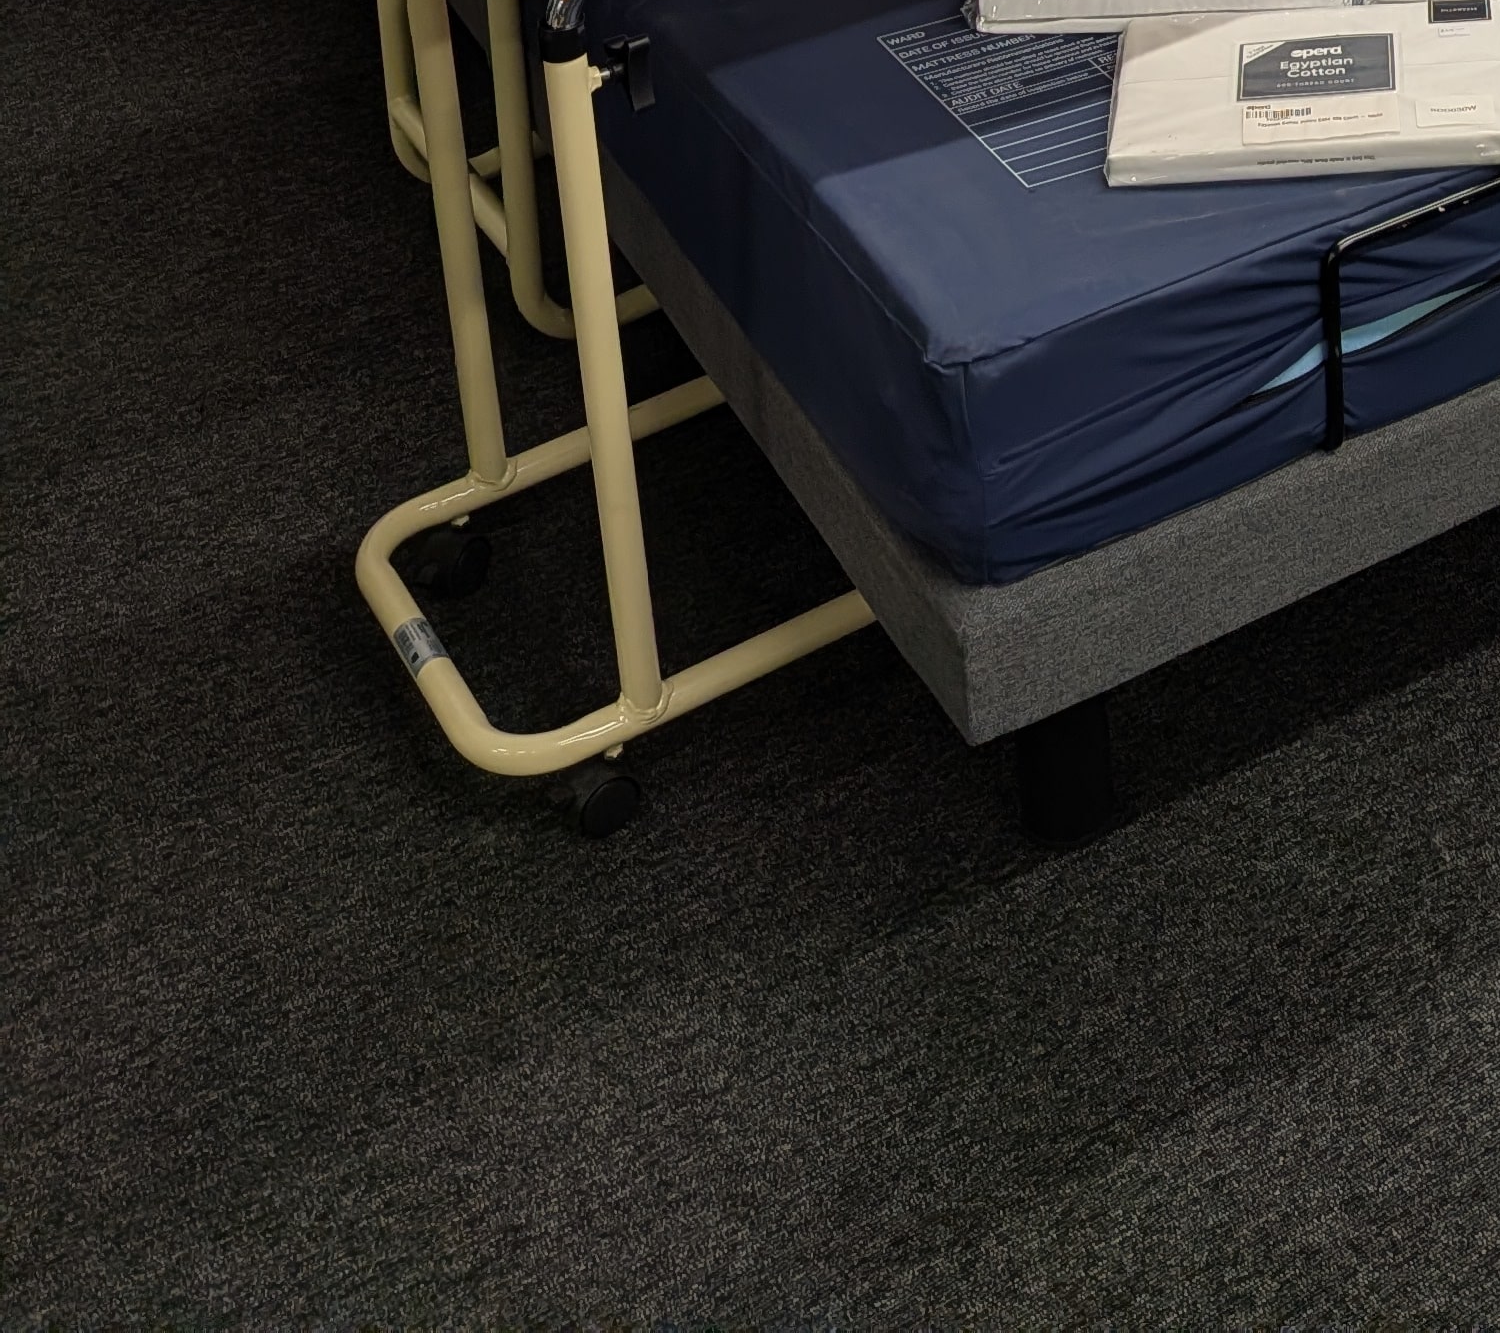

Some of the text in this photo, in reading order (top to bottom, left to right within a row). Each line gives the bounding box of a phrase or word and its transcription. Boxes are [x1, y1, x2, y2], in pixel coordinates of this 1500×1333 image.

[886, 31, 926, 46] WARD
[898, 46, 931, 59] DATE
[931, 40, 949, 50] OF
[911, 34, 1036, 72] MATTRESS NUMBER
[1291, 45, 1342, 60] opera
[1280, 57, 1354, 71] Egyptian
[1287, 67, 1346, 78] Cotton
[952, 80, 1024, 107] AUDIT DATE
